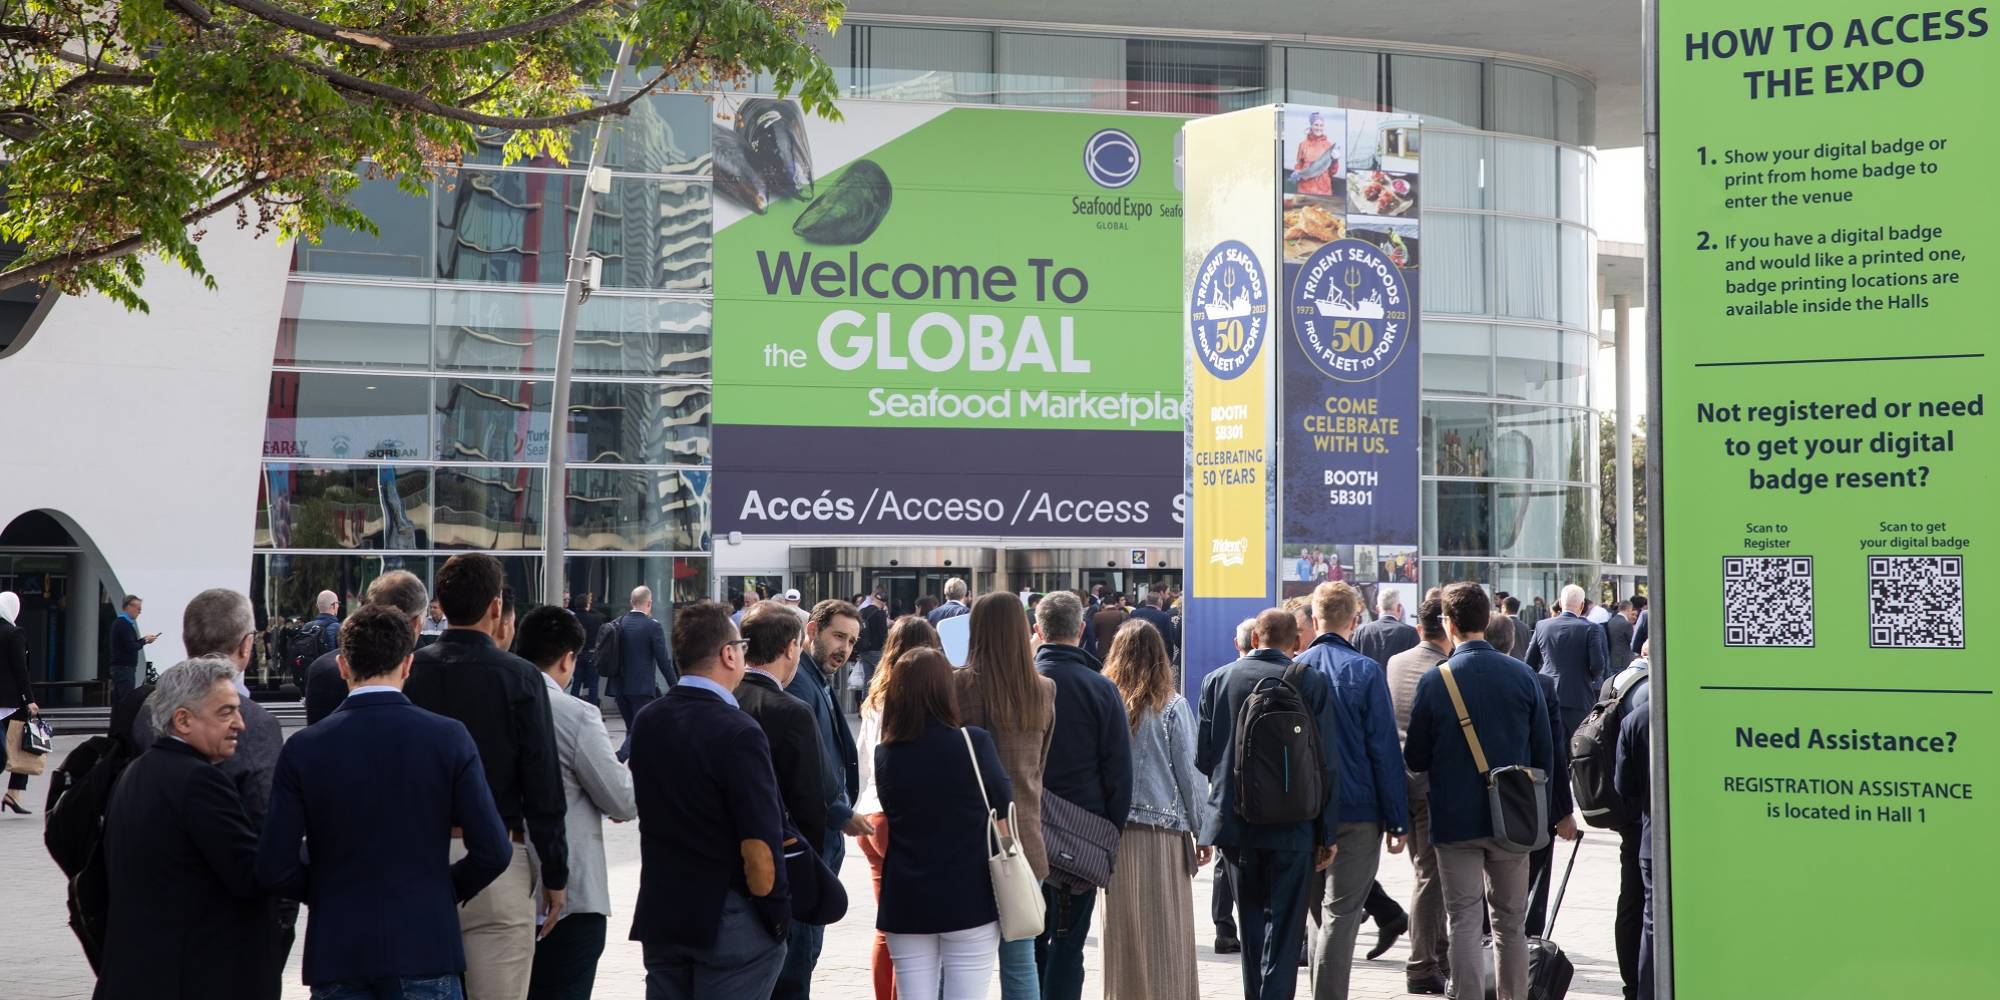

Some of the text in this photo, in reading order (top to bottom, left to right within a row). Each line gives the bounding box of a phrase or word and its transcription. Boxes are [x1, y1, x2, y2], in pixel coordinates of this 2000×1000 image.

[1686, 7, 1988, 61] HOW TO ACCESS
[1743, 58, 1924, 100] THE EXPO
[1697, 138, 1947, 166] 1. Show your digital badge or
[1725, 161, 1938, 190] print from home badge to
[1072, 196, 1153, 221] Seafood Expo
[1725, 191, 1853, 209] enter the venue
[1096, 221, 1128, 230] GLOBAL
[1696, 224, 1943, 252] 2. If you have a digital badge
[1725, 247, 1966, 271] and would like a printed one,
[756, 250, 1089, 304] Welcome To
[1197, 249, 1262, 306] TRIDENT SEAFOODS
[1303, 248, 1399, 304] TRIDENT SEAFOODS
[1726, 272, 1959, 296] badge printing locations are
[1296, 306, 1406, 319] 1973 2023
[1726, 293, 1929, 316] available inside the Halls
[764, 310, 1091, 373] the GLOBAL
[1198, 317, 1260, 371] FROM FLEET TO FORK
[1216, 320, 1244, 353] 50
[1305, 321, 1398, 371] FROM FLEET TO FORK
[1332, 320, 1373, 353] 50
[868, 387, 1011, 418] Seafood
[1211, 405, 1248, 421] BOOTH
[1325, 397, 1377, 415] COME
[1697, 394, 1983, 427] Not registered or need
[1303, 415, 1399, 435] CELEBRATE
[1314, 435, 1389, 454] WITH US.
[1724, 430, 1953, 461] to get your digital
[1196, 449, 1263, 465] CELEBRATING
[1203, 468, 1255, 485] 50 YEARS
[1324, 470, 1378, 486] BOOTH
[1750, 466, 1929, 495] badge resent?
[739, 489, 855, 521] Accés
[1330, 490, 1372, 505] 5B301
[1746, 522, 1788, 533] Scan to
[1880, 521, 1946, 535] Scan to get
[1744, 538, 1791, 551] Register
[1860, 536, 1970, 550] your digital badge
[1736, 727, 1957, 753] Need Assistance?
[1724, 776, 1973, 799] REGISTRATION ASSISTANCE
[1767, 802, 1925, 823] is located in Hall 1
